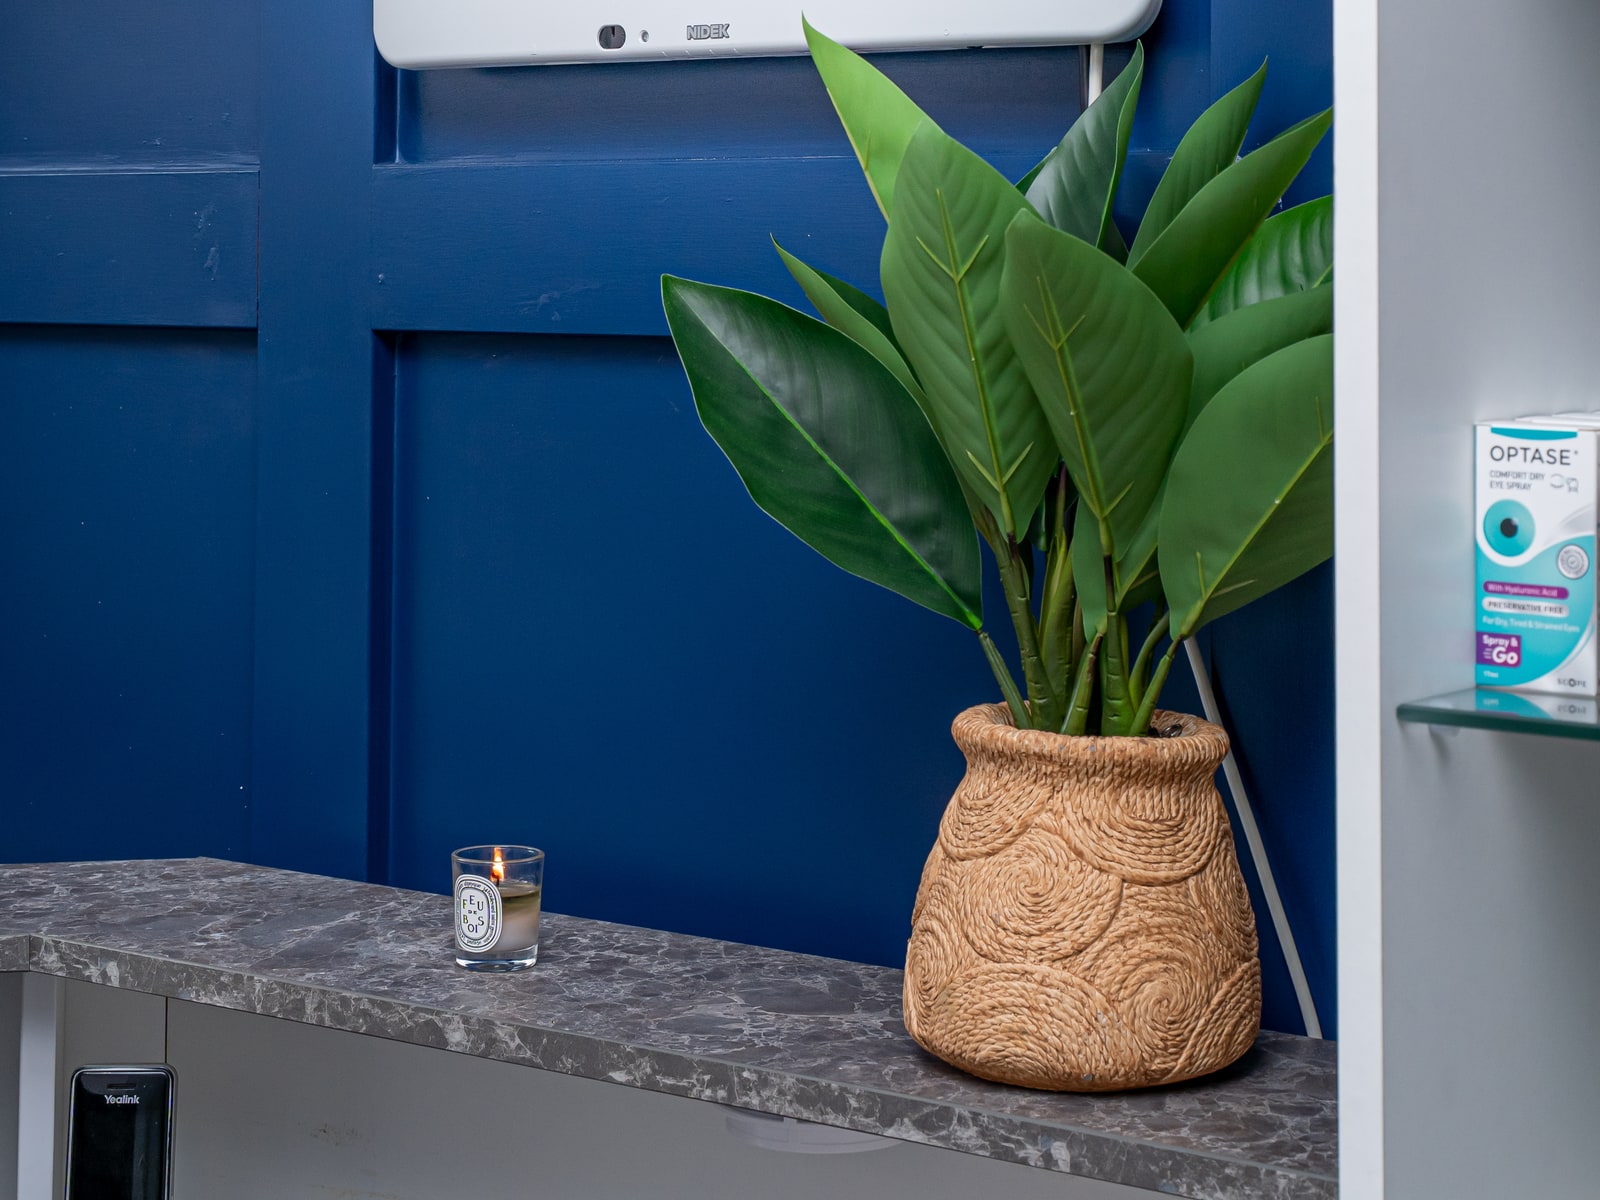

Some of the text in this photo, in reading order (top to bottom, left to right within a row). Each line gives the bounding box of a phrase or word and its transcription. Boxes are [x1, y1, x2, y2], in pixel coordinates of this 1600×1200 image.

[686, 23, 730, 40] NIDEK
[1489, 445, 1572, 466] OPTASE
[1489, 470, 1546, 481] COMFORT DRY
[1489, 481, 1533, 491] EYE SPRAY
[1487, 583, 1503, 592] With
[1542, 588, 1558, 597] Acid
[1488, 601, 1563, 614] PRESERVATIVE FREE
[1482, 635, 1510, 648] Spray
[1492, 646, 1518, 665] Go
[104, 1094, 140, 1105] Yealink
